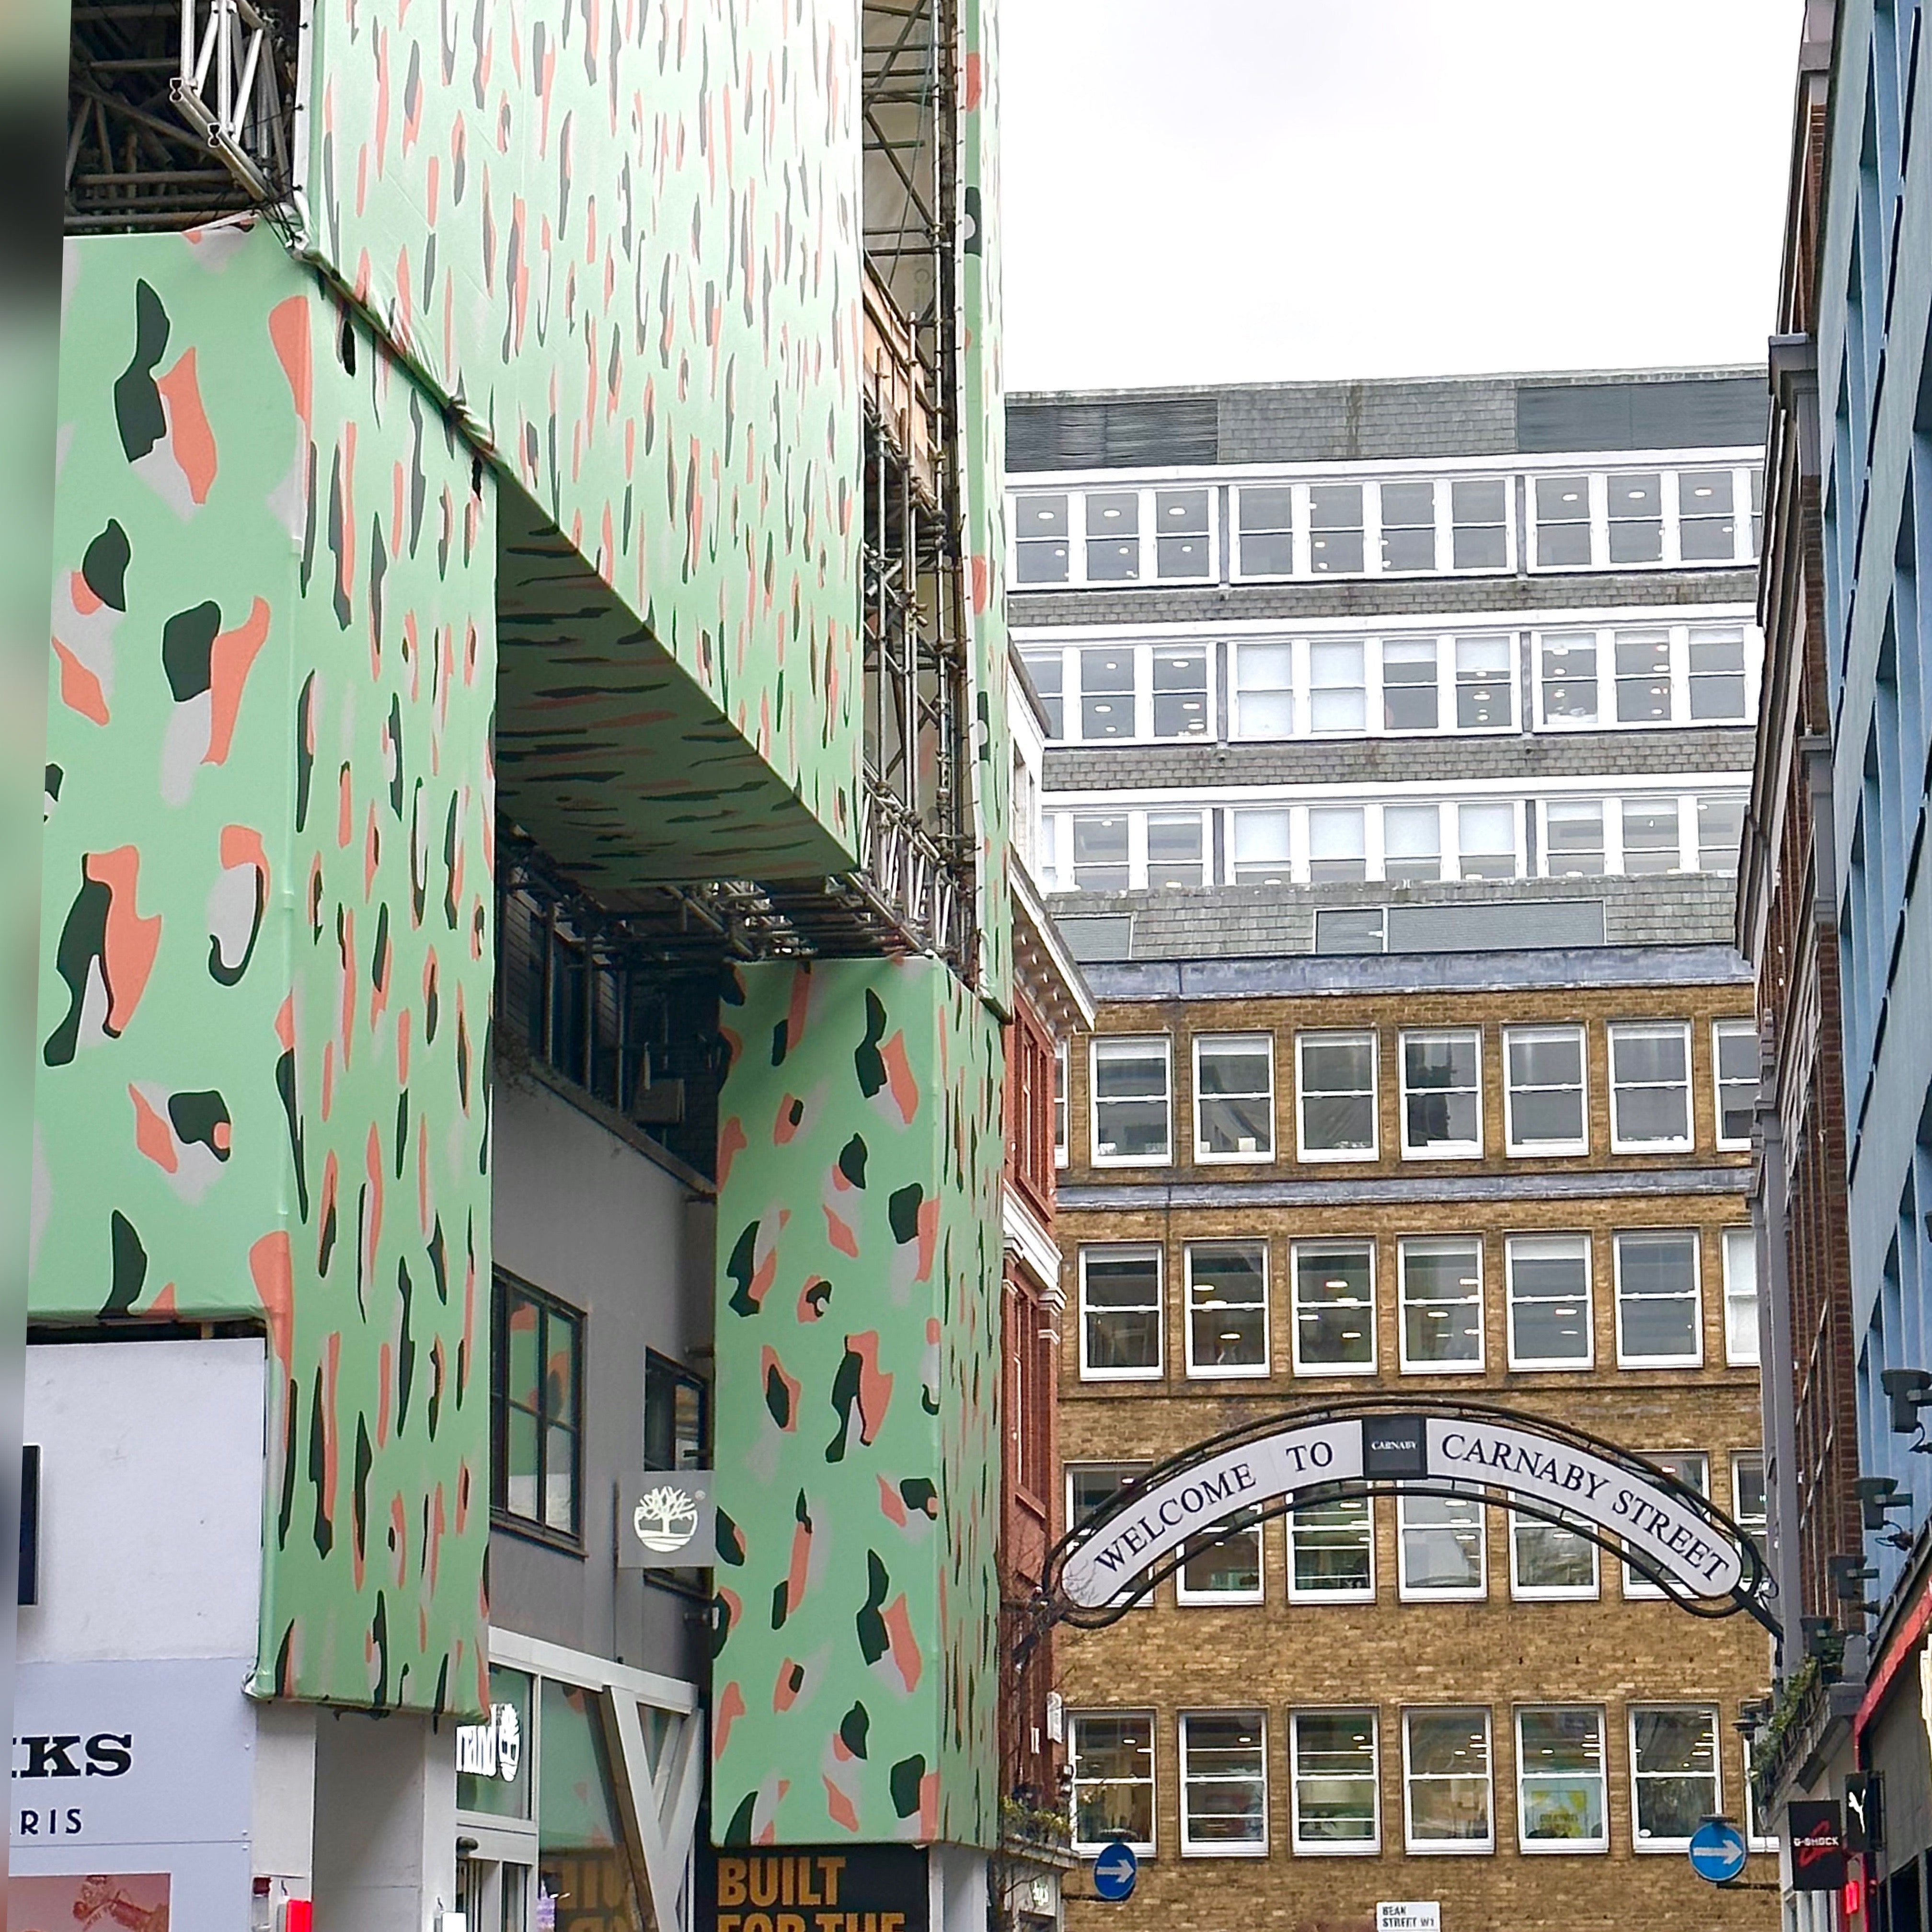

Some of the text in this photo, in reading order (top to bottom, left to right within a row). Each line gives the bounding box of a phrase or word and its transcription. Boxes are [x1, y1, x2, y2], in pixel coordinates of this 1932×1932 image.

[1371, 1440, 1417, 1450] CARNABY
[1094, 1433, 1730, 1581] WELCOME TO CARNABY STREET
[12, 1733, 132, 1778] KS
[10, 1808, 82, 1835] RIS
[1794, 1836, 1840, 1847] G-SHOCK
[716, 1856, 846, 1908] BUILT
[1382, 1906, 1406, 1916] BEAK
[1382, 1917, 1434, 1928] STREET W1
